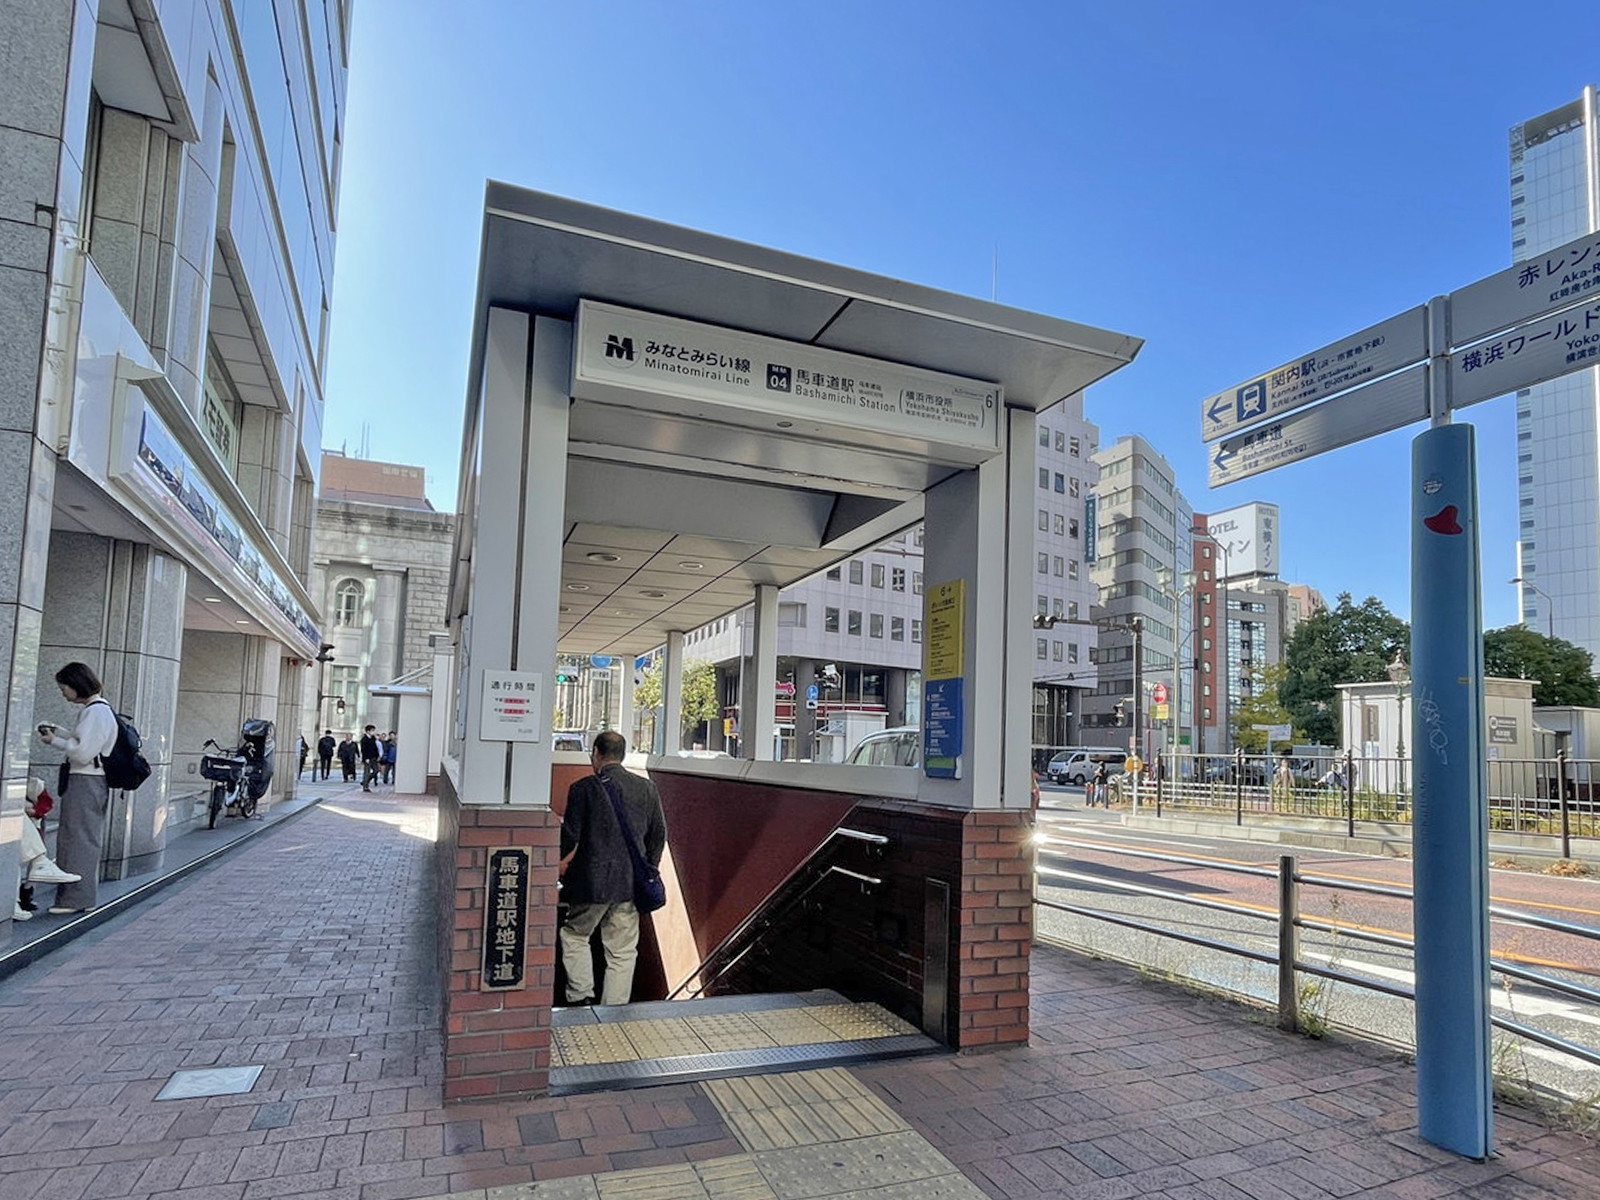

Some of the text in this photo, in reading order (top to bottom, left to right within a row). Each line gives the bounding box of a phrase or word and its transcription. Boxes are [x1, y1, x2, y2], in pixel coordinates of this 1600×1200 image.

[1518, 242, 1600, 289] 赤レン
[1462, 305, 1600, 372] 横浜ワールド
[645, 340, 751, 373] みなとみらい線
[644, 357, 750, 386] Minatomirai Line
[770, 375, 788, 389] 04
[796, 368, 854, 393] 馬車道駅
[795, 384, 856, 405] Bashamichi
[859, 396, 896, 413] Station
[985, 394, 993, 408] 6
[1209, 519, 1239, 535] OTEL
[493, 856, 519, 981] 馬車道駅地下道
